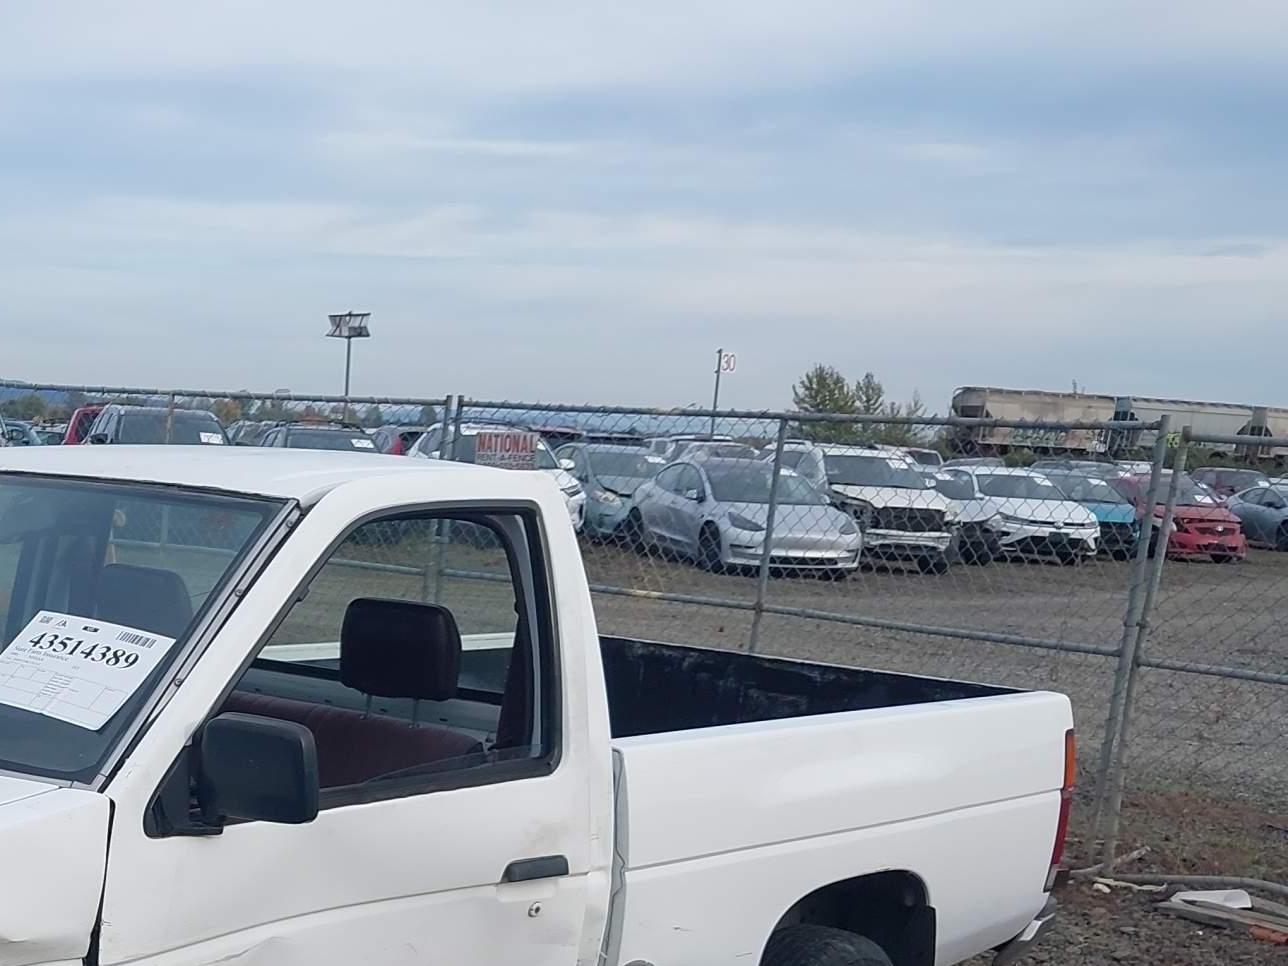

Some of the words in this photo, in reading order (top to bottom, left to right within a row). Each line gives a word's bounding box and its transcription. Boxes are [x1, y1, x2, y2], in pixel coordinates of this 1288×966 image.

[722, 353, 736, 371] 30
[477, 434, 536, 453] NATIONAL
[28, 631, 140, 669] 43514389
